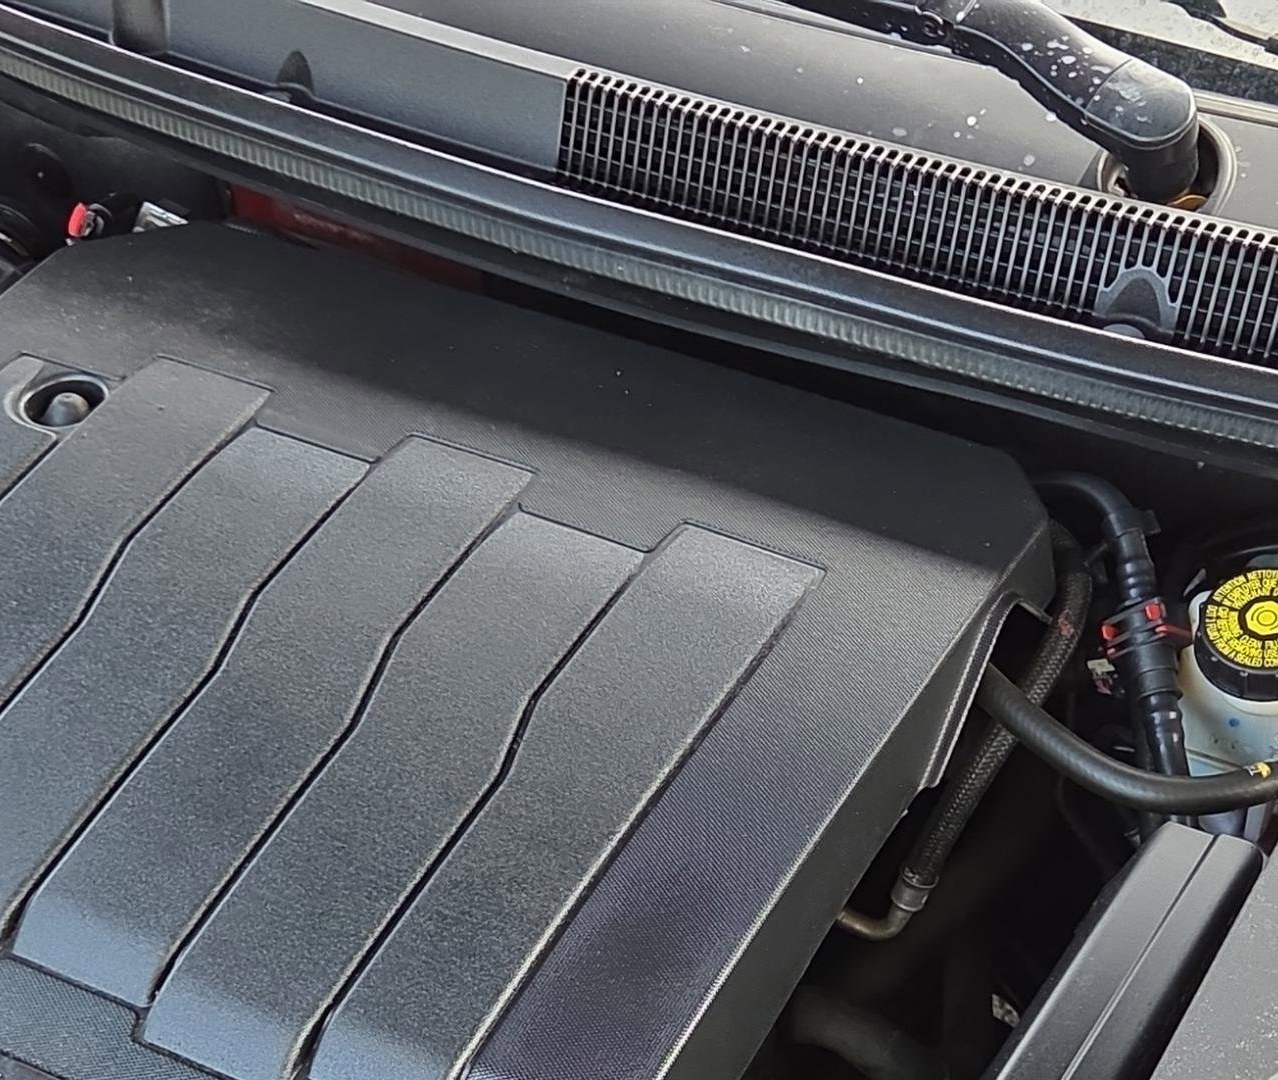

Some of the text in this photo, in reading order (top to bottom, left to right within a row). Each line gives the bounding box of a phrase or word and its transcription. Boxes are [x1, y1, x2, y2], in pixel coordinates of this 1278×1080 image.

[1212, 573, 1247, 602] ATTENTION
[1262, 578, 1278, 587] QUE
[1214, 637, 1235, 654] FROM
[1234, 651, 1262, 666] SEALED
[1228, 637, 1263, 658] REMOVING
[1239, 633, 1263, 649] CLEAN
